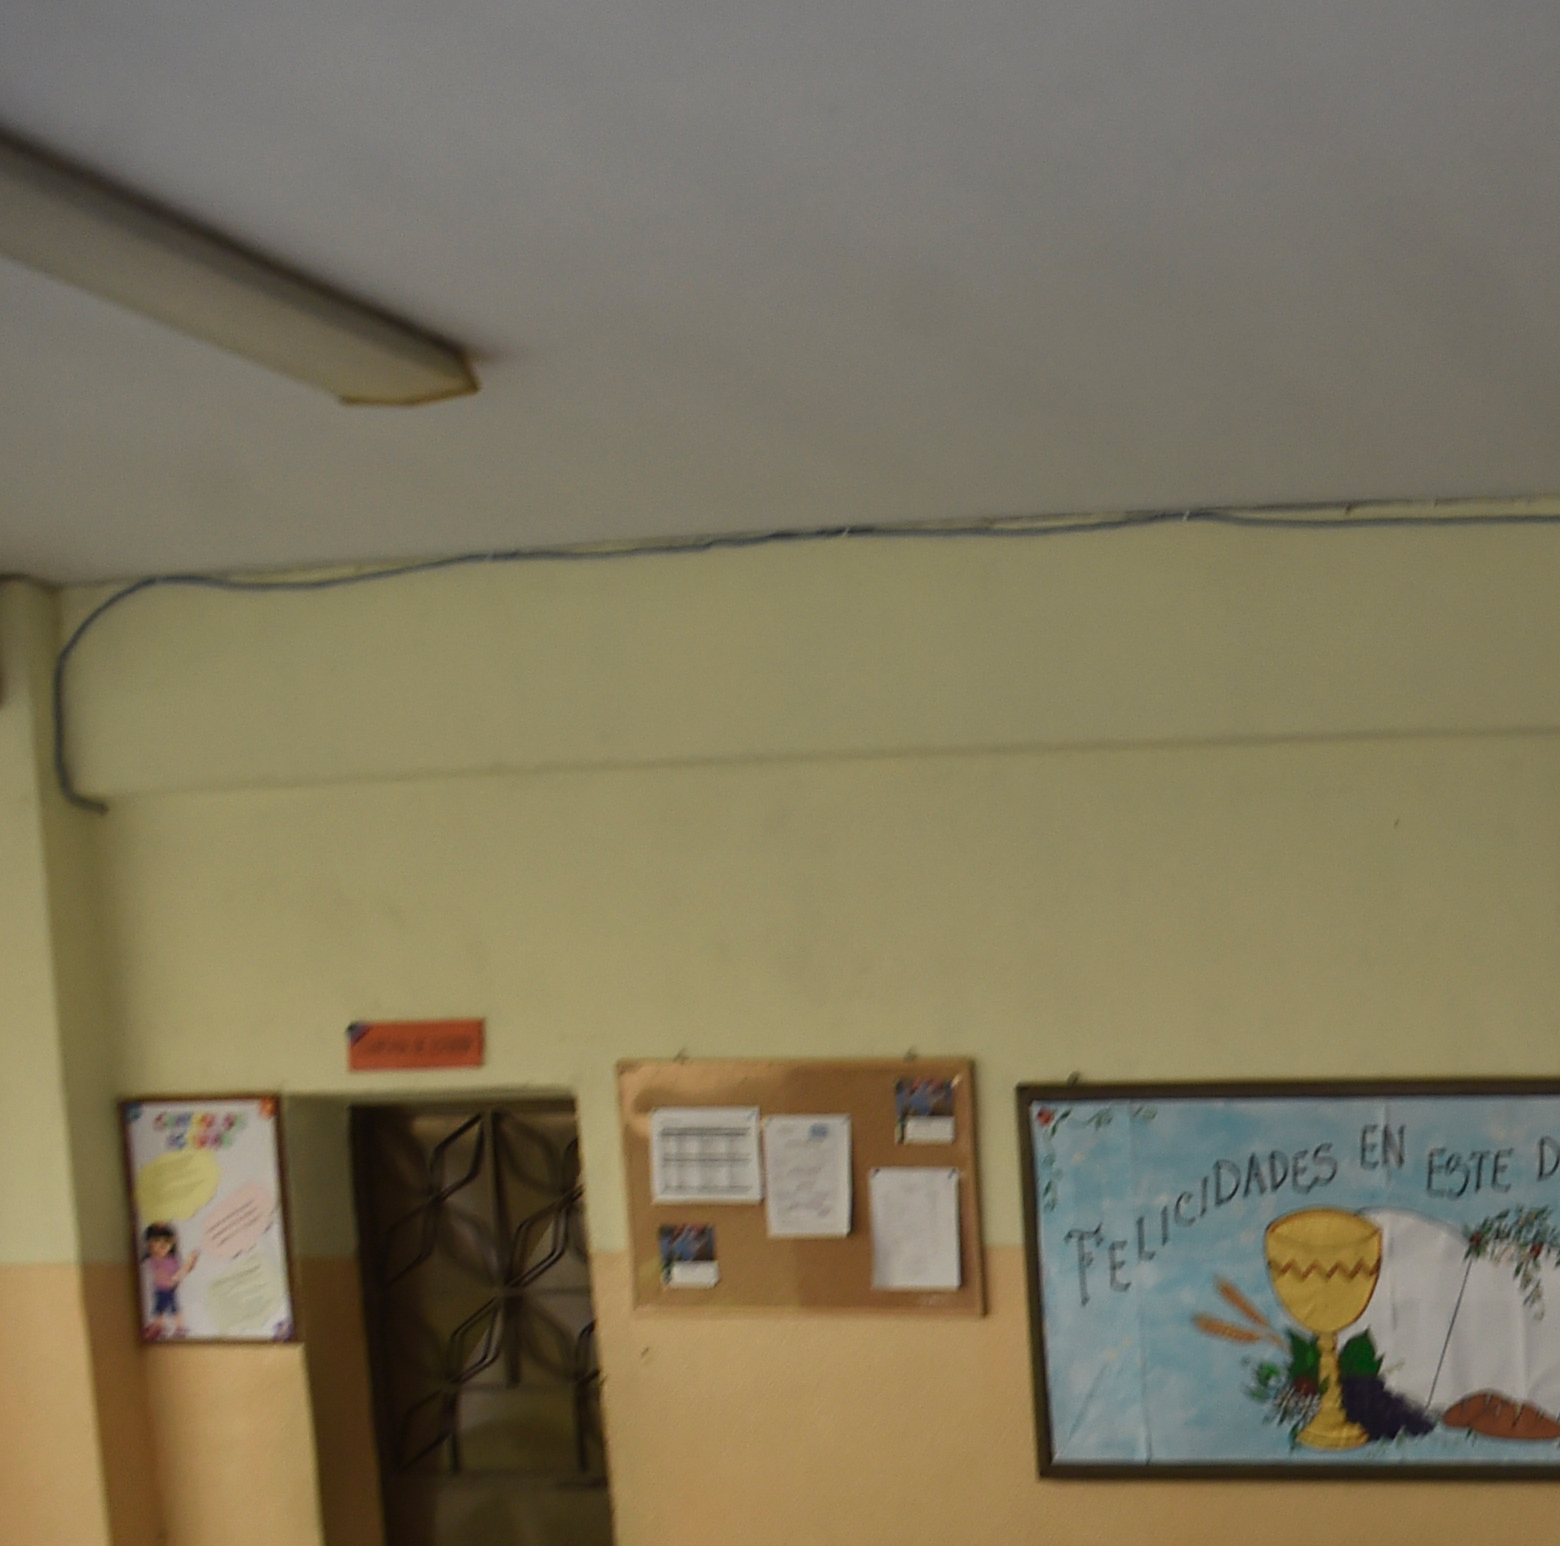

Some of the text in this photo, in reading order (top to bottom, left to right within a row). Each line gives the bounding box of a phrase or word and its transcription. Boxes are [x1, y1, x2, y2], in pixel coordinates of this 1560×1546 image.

[1064, 1142, 1339, 1307] FELICIDADES
[1359, 1124, 1406, 1170] EN
[1425, 1146, 1515, 1199] ESTE
